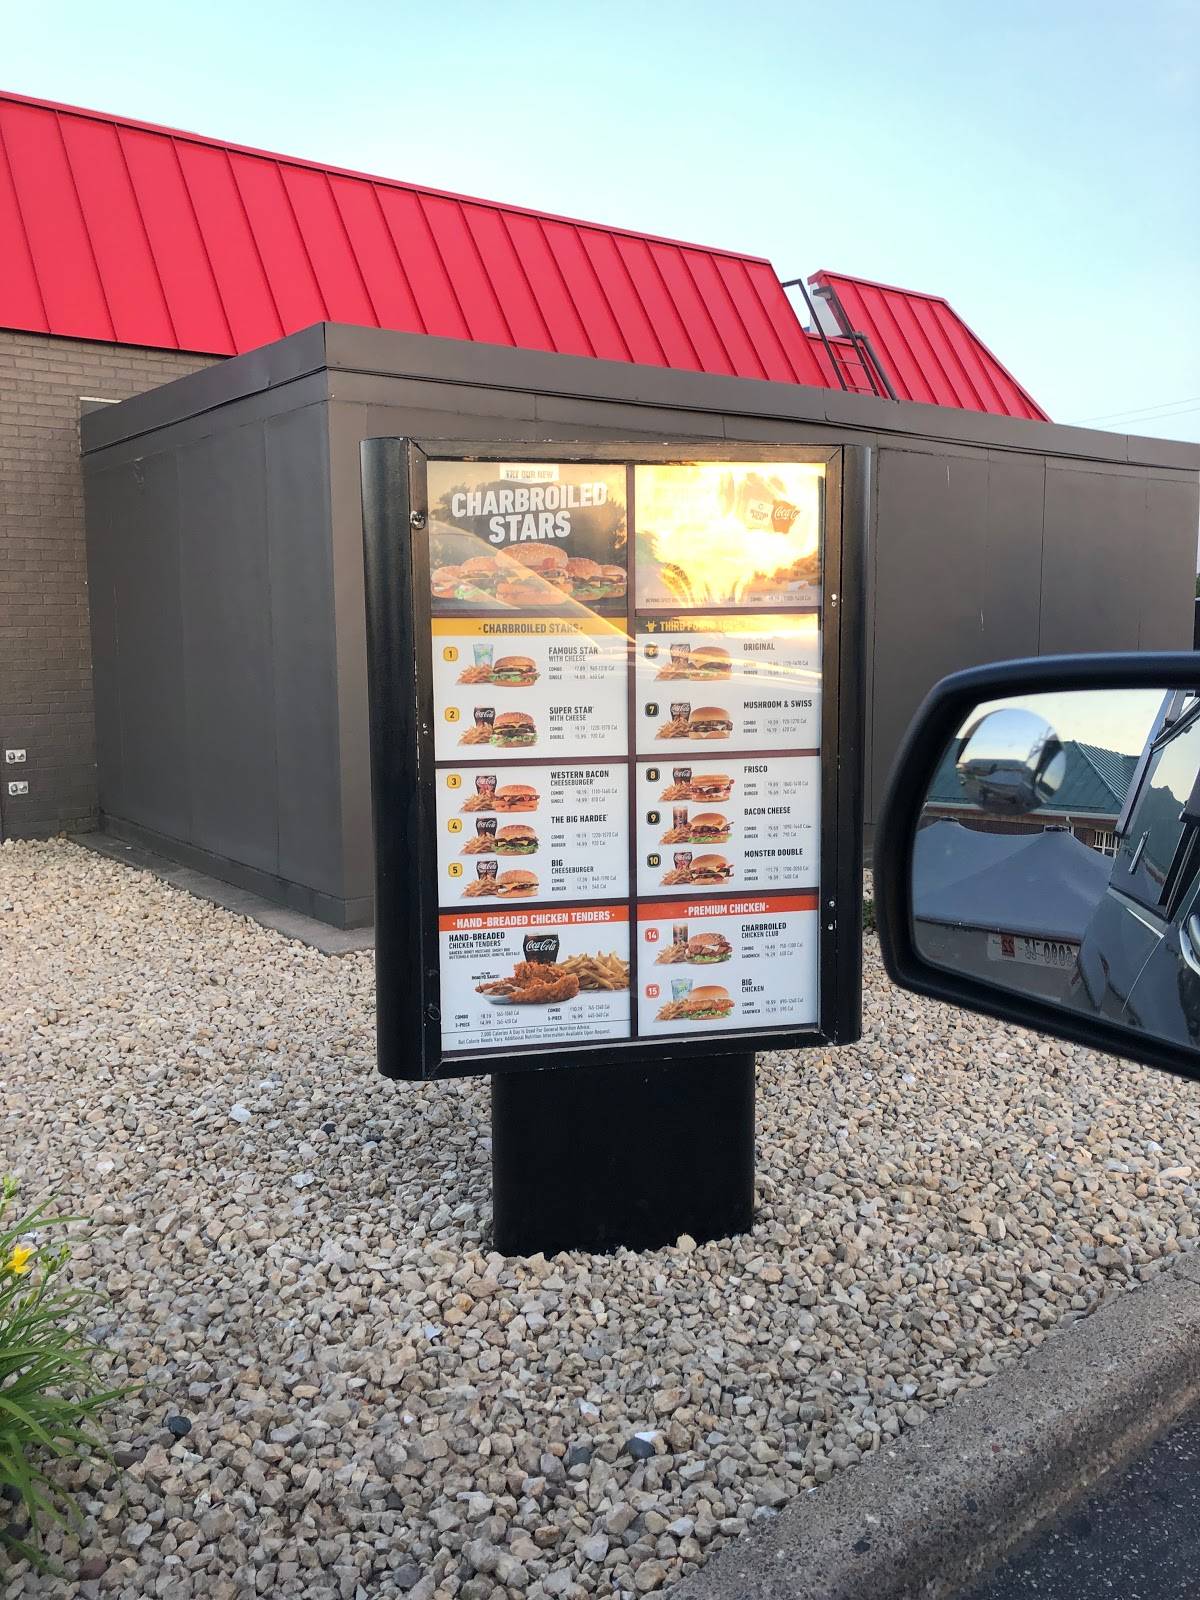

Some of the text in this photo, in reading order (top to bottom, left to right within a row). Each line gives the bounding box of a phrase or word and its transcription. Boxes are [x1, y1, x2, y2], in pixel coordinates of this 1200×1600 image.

[451, 480, 608, 518] CHARBROILED
[488, 510, 571, 544] STARS
[483, 622, 579, 634] CHARBROILED STARS
[548, 646, 599, 655] FAMOUS STAR
[743, 643, 775, 651] ORIGINAL
[448, 650, 453, 659] 1
[743, 699, 813, 709] MUSHROOM & SWISS
[549, 706, 593, 715] SUPER STAR
[649, 705, 655, 714] 7
[449, 710, 455, 719] 2
[550, 769, 610, 779] WESTERN BACON
[743, 765, 768, 774] FRISCO
[650, 771, 656, 779] 8
[451, 777, 457, 786] 3
[550, 779, 594, 787] CHEESEBURGER
[744, 806, 791, 816] BACON CHEESE
[551, 813, 607, 824] THE BIG HARDEE
[650, 814, 656, 822] 9
[451, 822, 457, 830] 4
[744, 847, 804, 858] MONSTER DOUBLE
[551, 859, 563, 867] BIG
[649, 856, 659, 865] 10
[452, 866, 458, 874] 5
[551, 866, 594, 875] CHEESEBURGER
[688, 902, 766, 917] PREMIUM CHICKEN
[456, 910, 610, 929] HAND-BREADED CHICKEN TENDERS
[741, 922, 787, 932] CHARBROILED
[448, 931, 505, 942] HAND-BREADED
[647, 931, 657, 940] 14
[741, 931, 764, 939] CHICKEN
[448, 940, 501, 950] CHICKEN TENDERS
[526, 938, 557, 952] Coca-Cola
[741, 978, 753, 986] BIG
[648, 987, 658, 996] 15
[741, 985, 765, 993] CHICKEN
